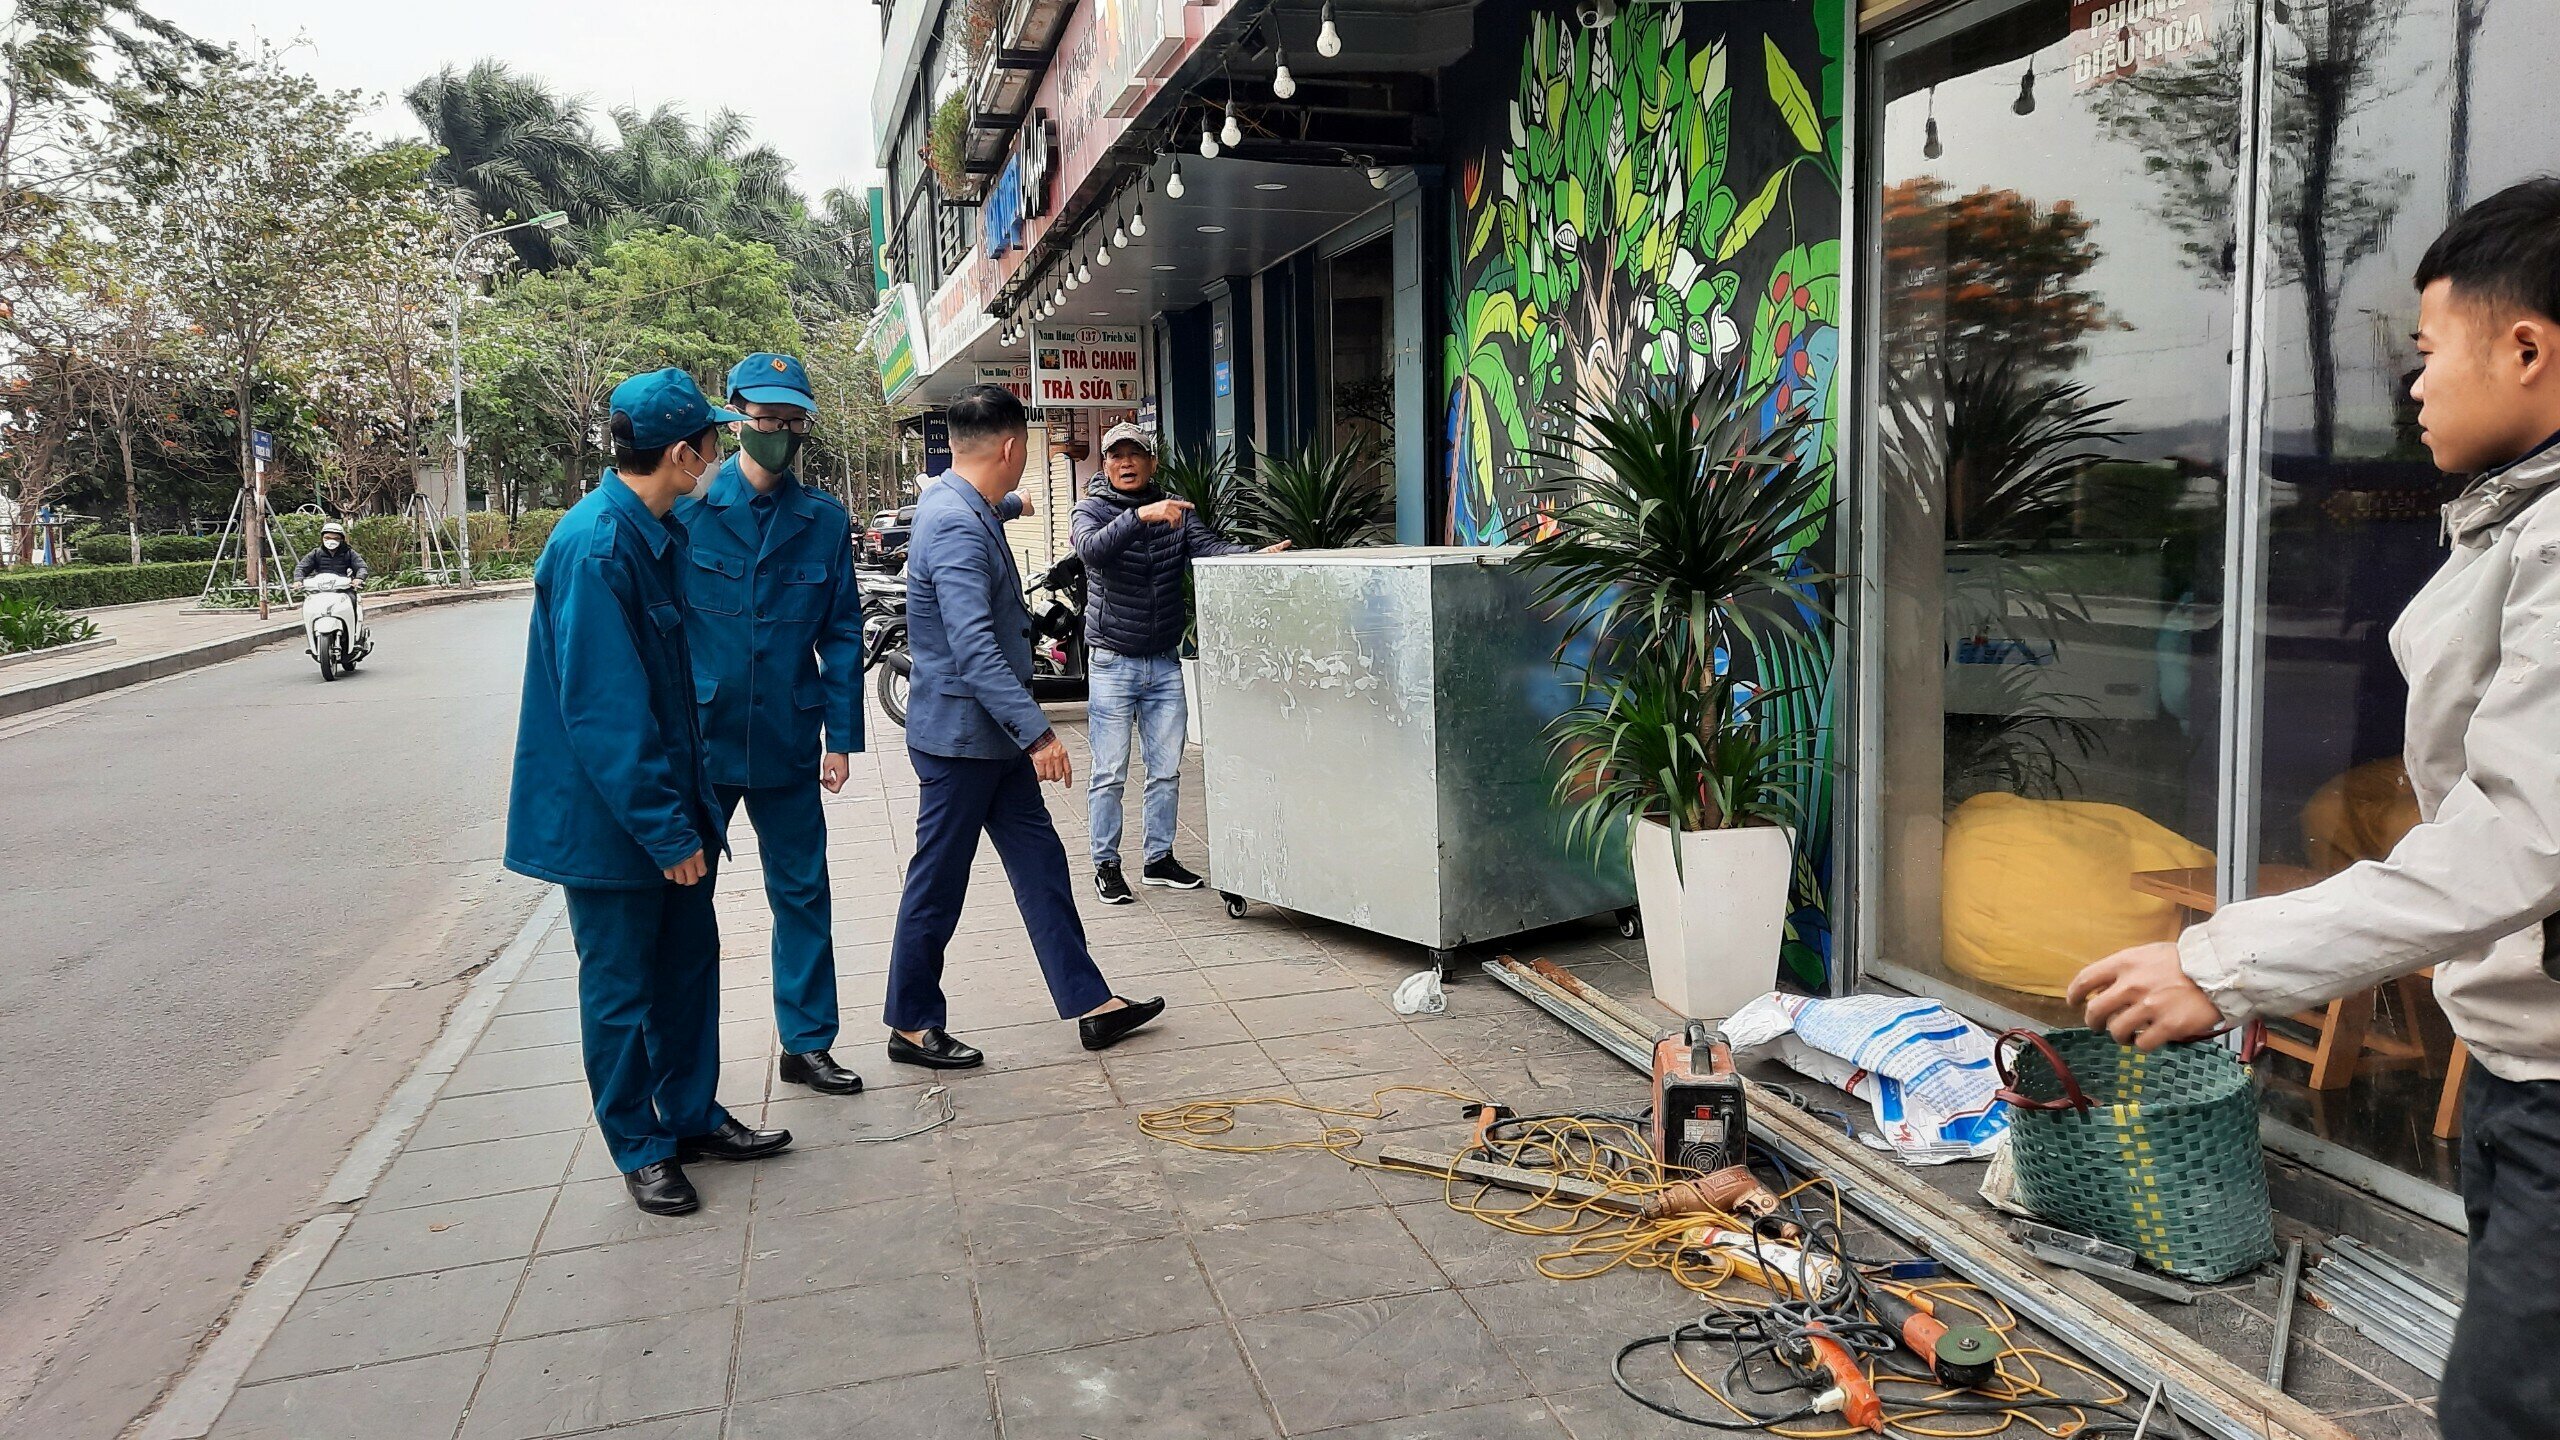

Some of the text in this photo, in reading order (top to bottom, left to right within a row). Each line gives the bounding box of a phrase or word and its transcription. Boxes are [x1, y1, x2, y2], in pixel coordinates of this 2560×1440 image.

[2144, 13, 2204, 60] HÒA
[1081, 331, 1097, 341] 137
[1062, 346, 1137, 370] TRÀ CHANH
[1015, 368, 1028, 377] 137
[1042, 376, 1113, 400] TRÀ SỮA
